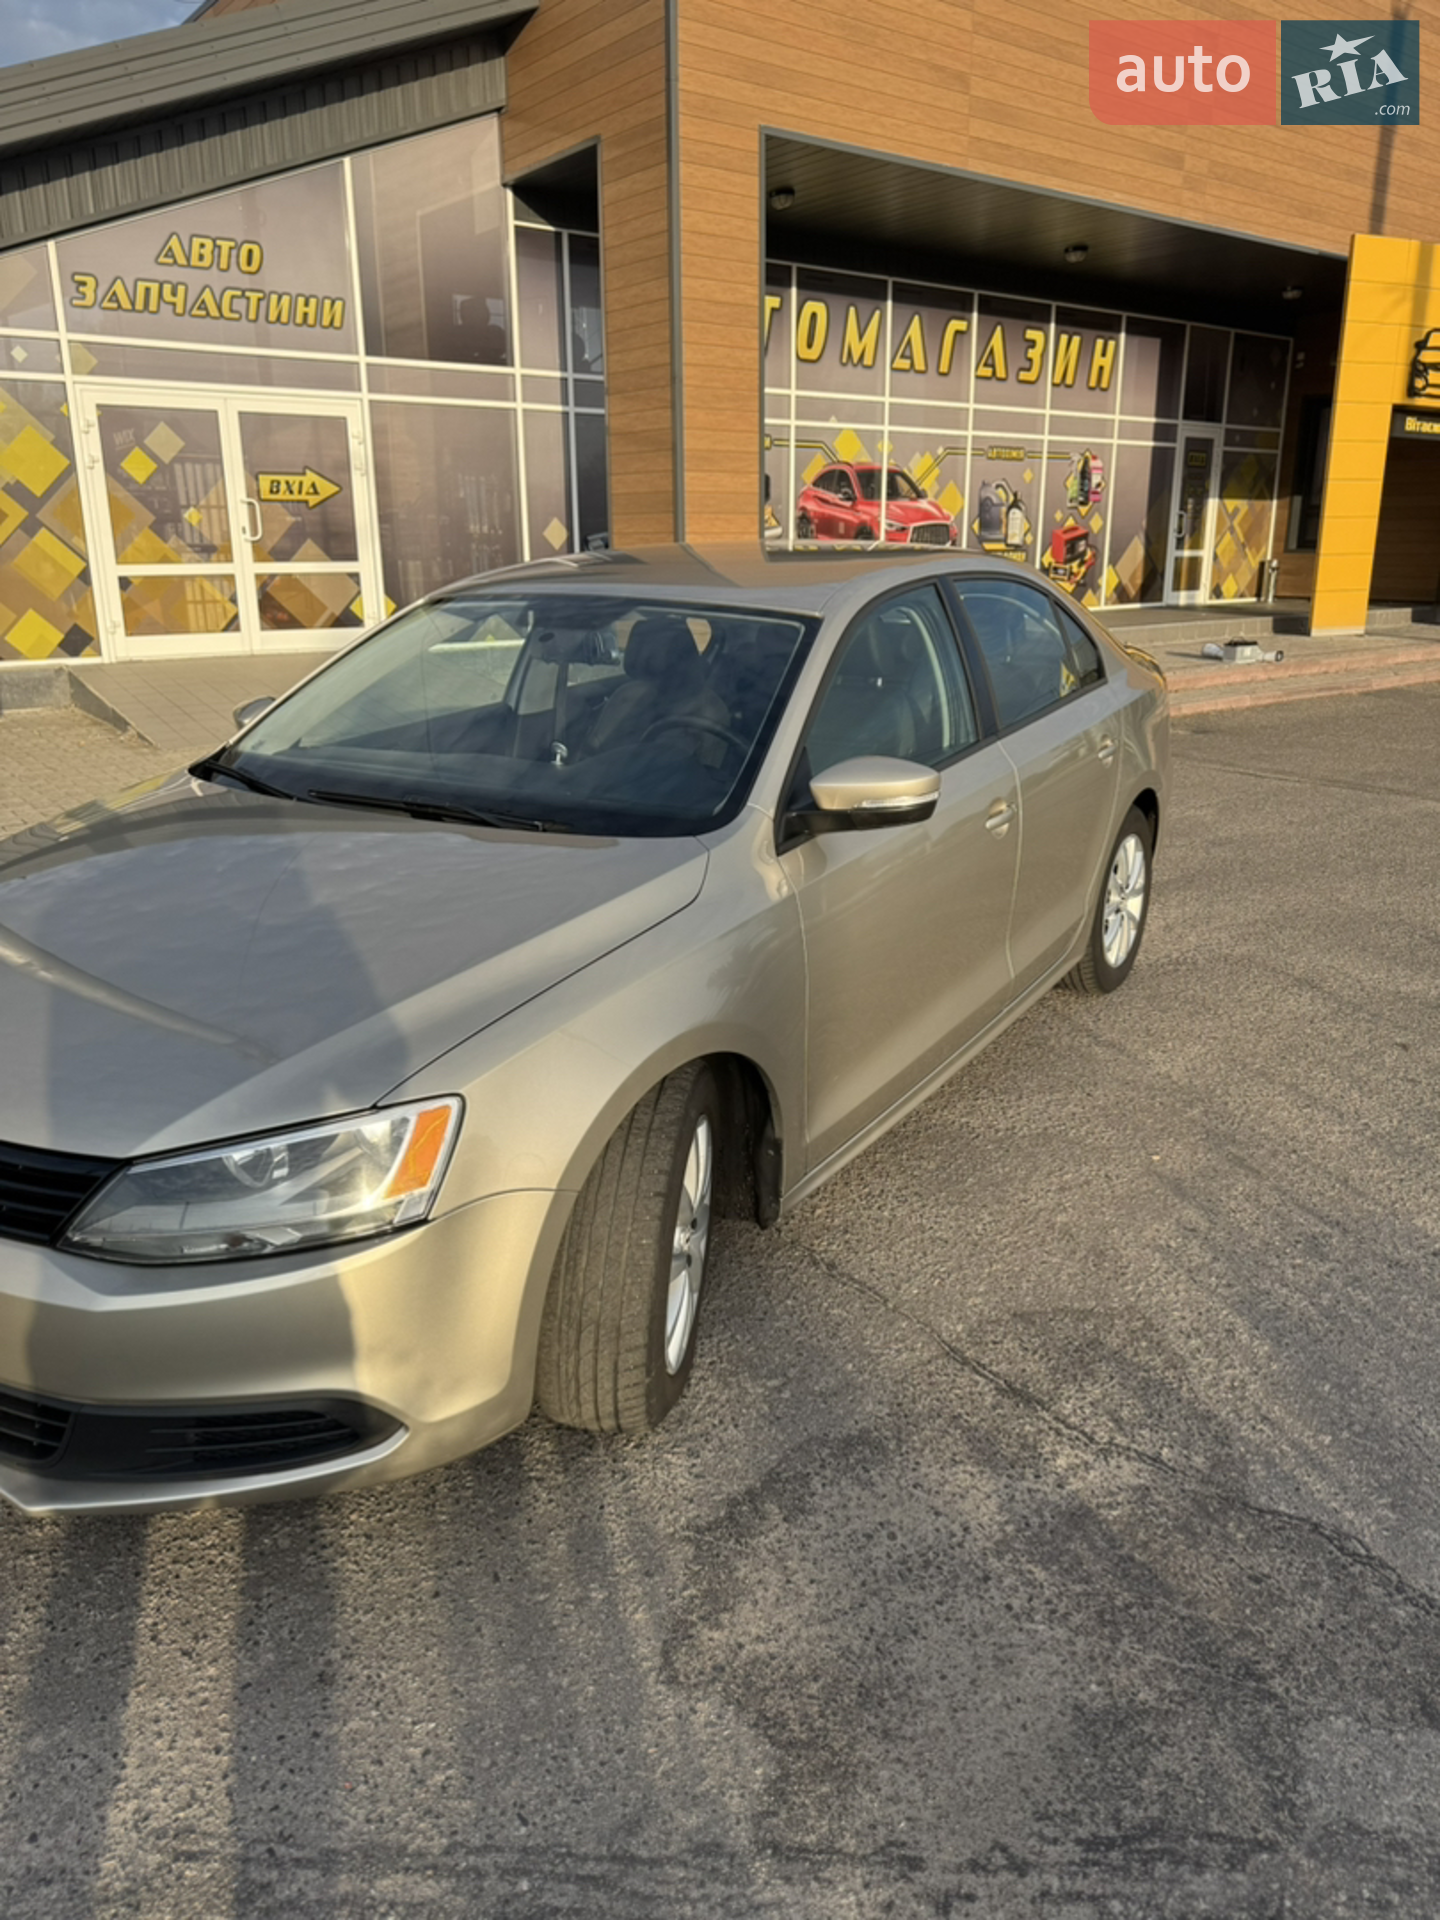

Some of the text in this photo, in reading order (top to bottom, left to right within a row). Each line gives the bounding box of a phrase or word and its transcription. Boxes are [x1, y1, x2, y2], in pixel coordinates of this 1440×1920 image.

[156, 232, 263, 274] АВТО
[70, 272, 345, 329] ЗАПЧАСТИНИ
[268, 479, 320, 496] ВХІД
